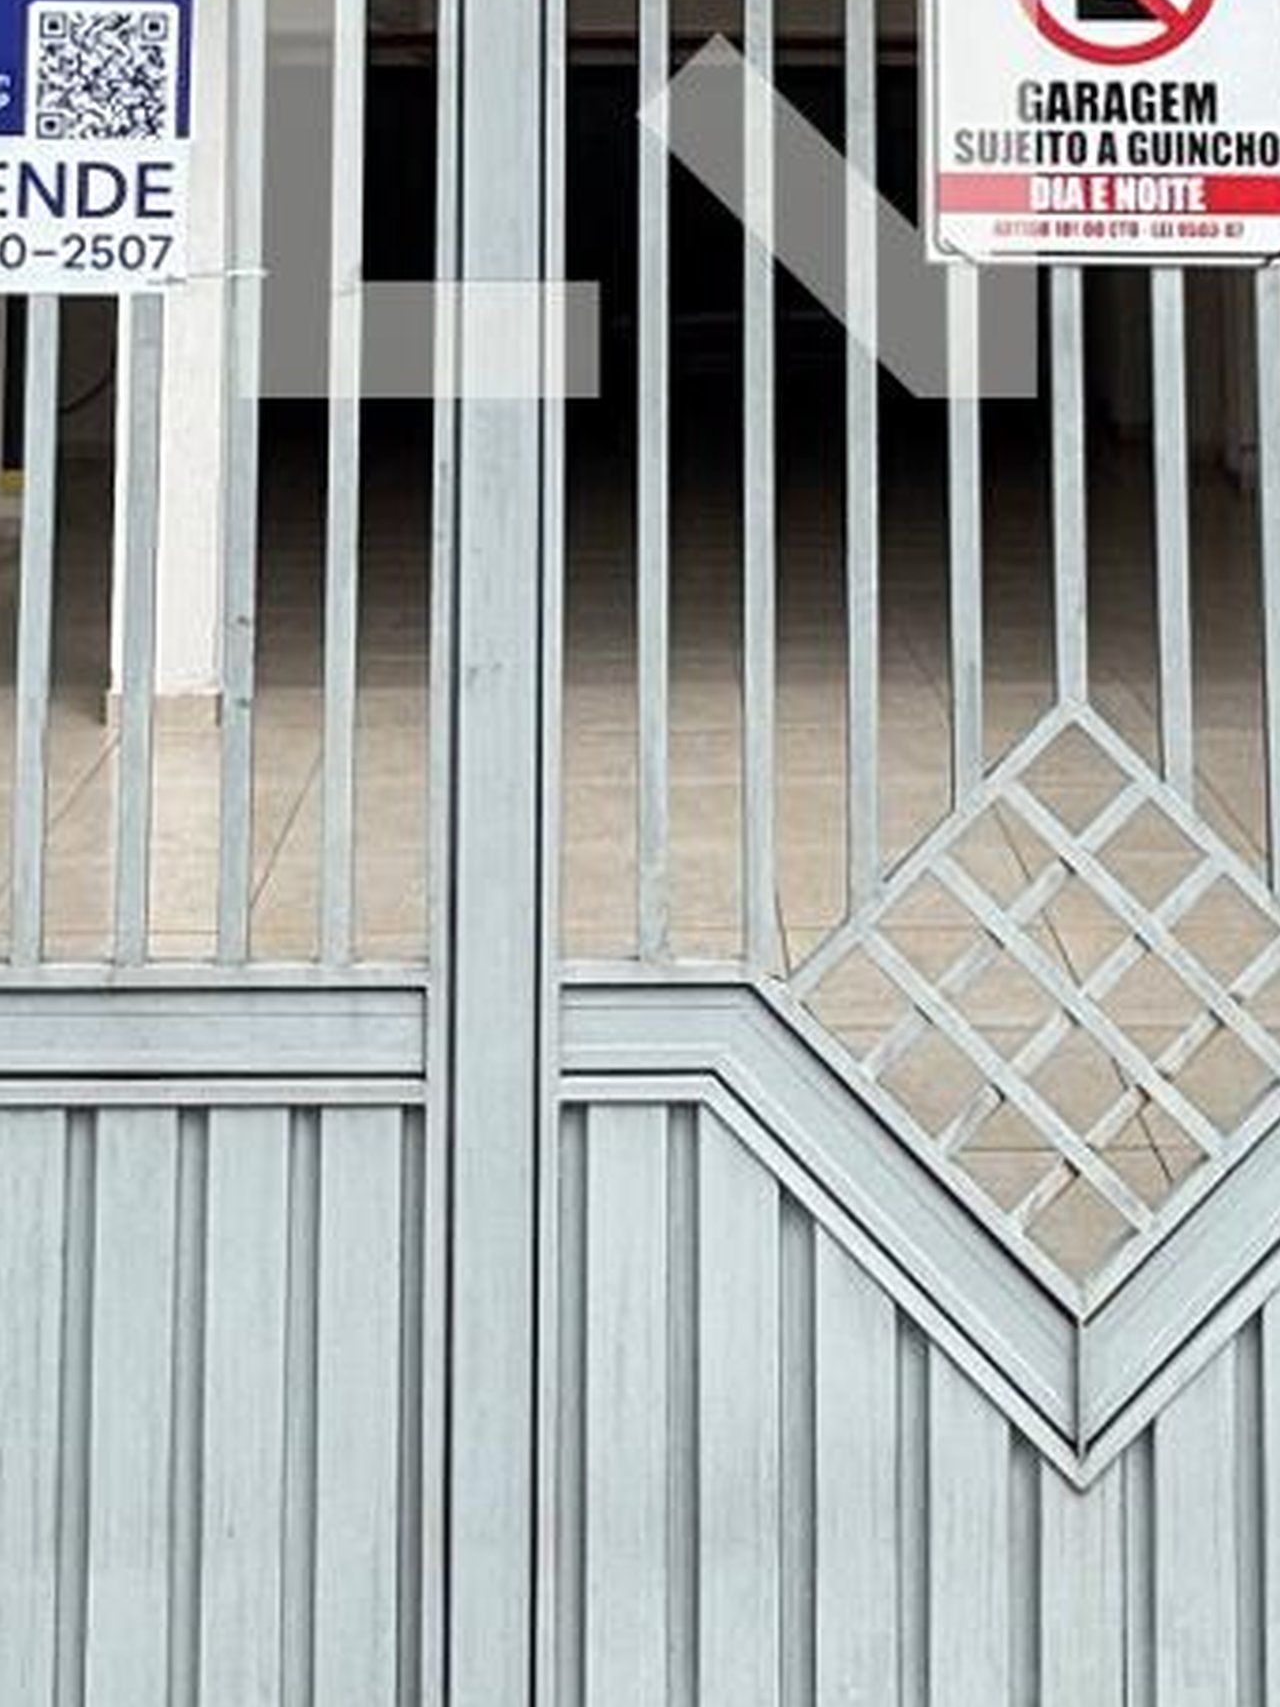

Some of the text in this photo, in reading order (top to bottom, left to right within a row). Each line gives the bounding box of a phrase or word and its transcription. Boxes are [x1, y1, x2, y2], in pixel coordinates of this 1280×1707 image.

[1017, 81, 1218, 124] GARAGEM
[954, 129, 1280, 167] SUJEITO A GUINCHO
[1029, 176, 1207, 212] DIA E NOITE
